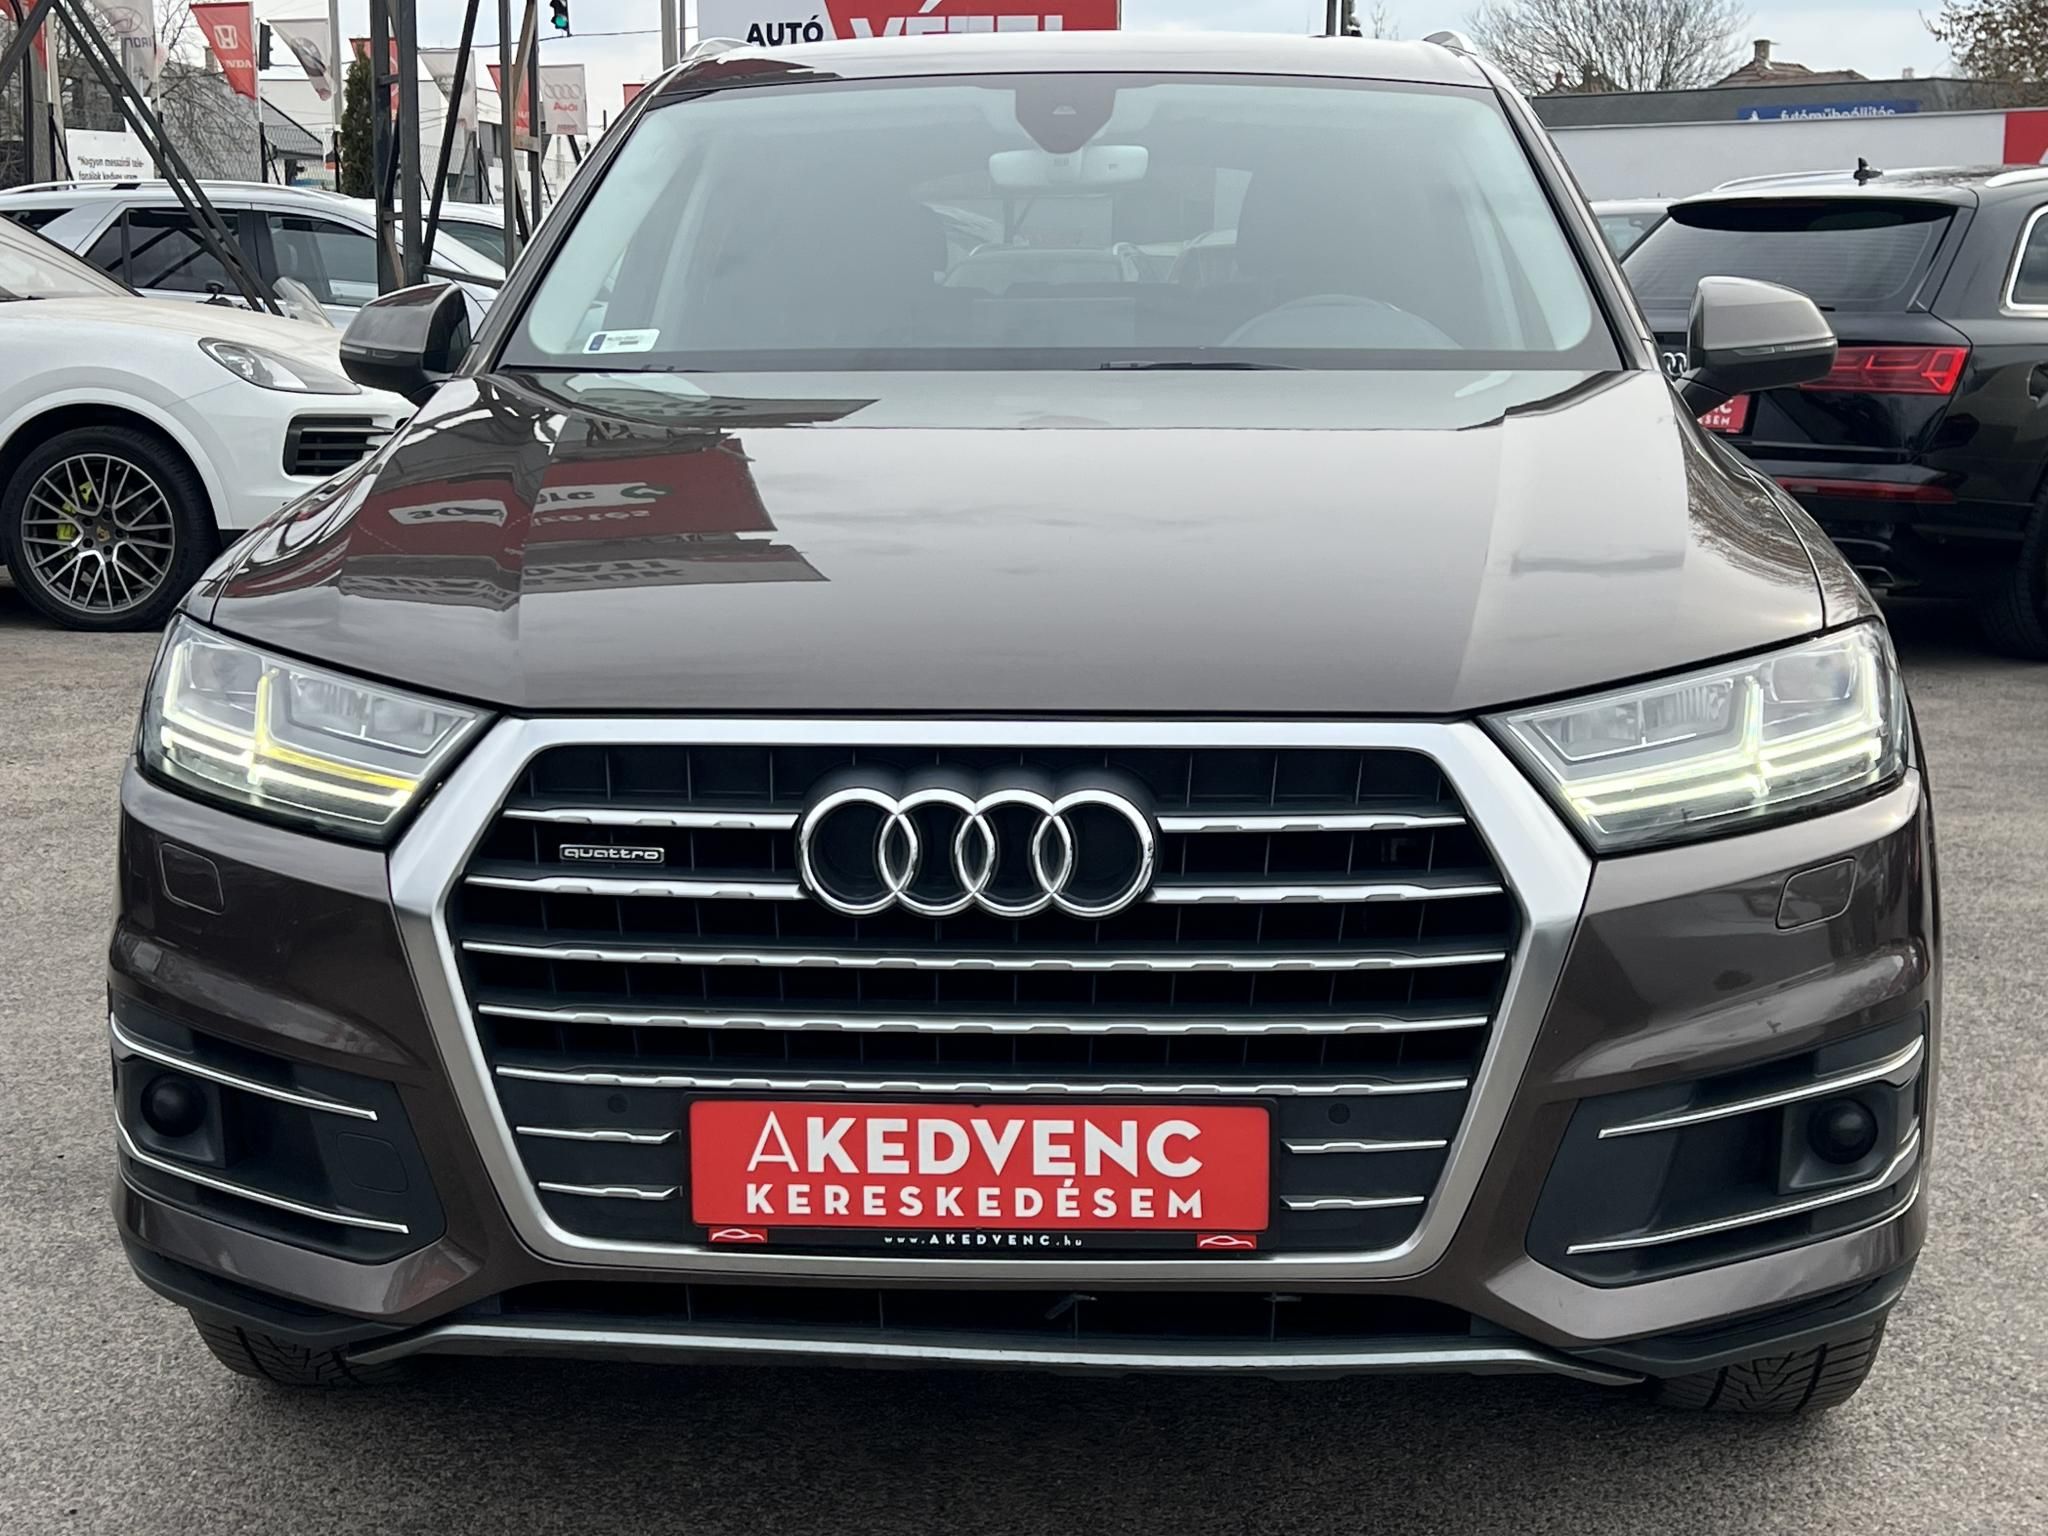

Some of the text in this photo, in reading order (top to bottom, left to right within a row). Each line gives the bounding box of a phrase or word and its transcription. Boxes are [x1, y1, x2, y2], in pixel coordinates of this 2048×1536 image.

[746, 15, 824, 46] AUTÓ
[563, 848, 660, 860] quattro
[746, 1179, 1202, 1219] KERESKEDÉSEM
[883, 1233, 1084, 1248] www.AKEDVENC.hu
